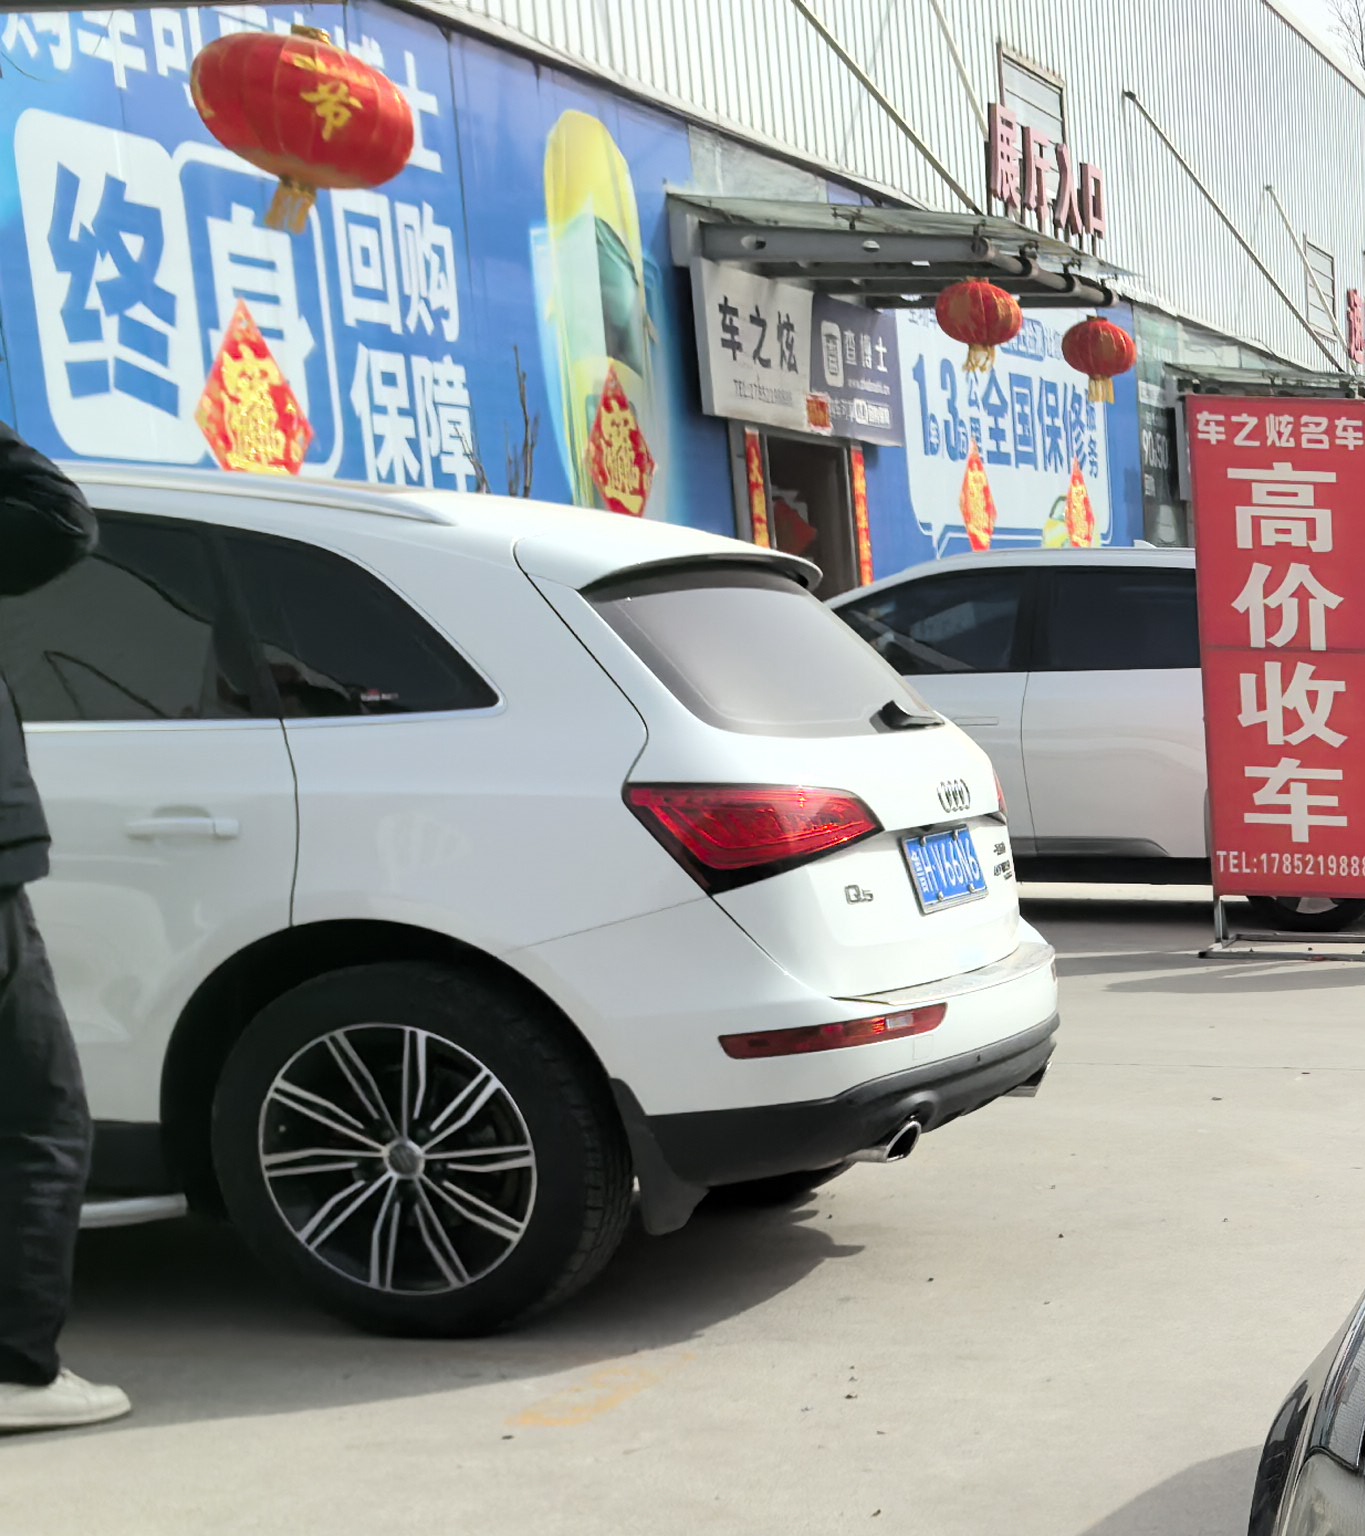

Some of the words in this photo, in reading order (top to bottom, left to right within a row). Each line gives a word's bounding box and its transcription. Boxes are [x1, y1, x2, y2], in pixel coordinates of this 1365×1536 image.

[989, 103, 1106, 239] 展厅入口
[332, 187, 458, 343] 回购
[718, 295, 799, 374] 车之炫
[350, 343, 476, 492] 保障
[1196, 411, 1364, 449] 车之炫名车
[1226, 462, 1348, 843] 高价收车
[844, 884, 875, 905] Q5
